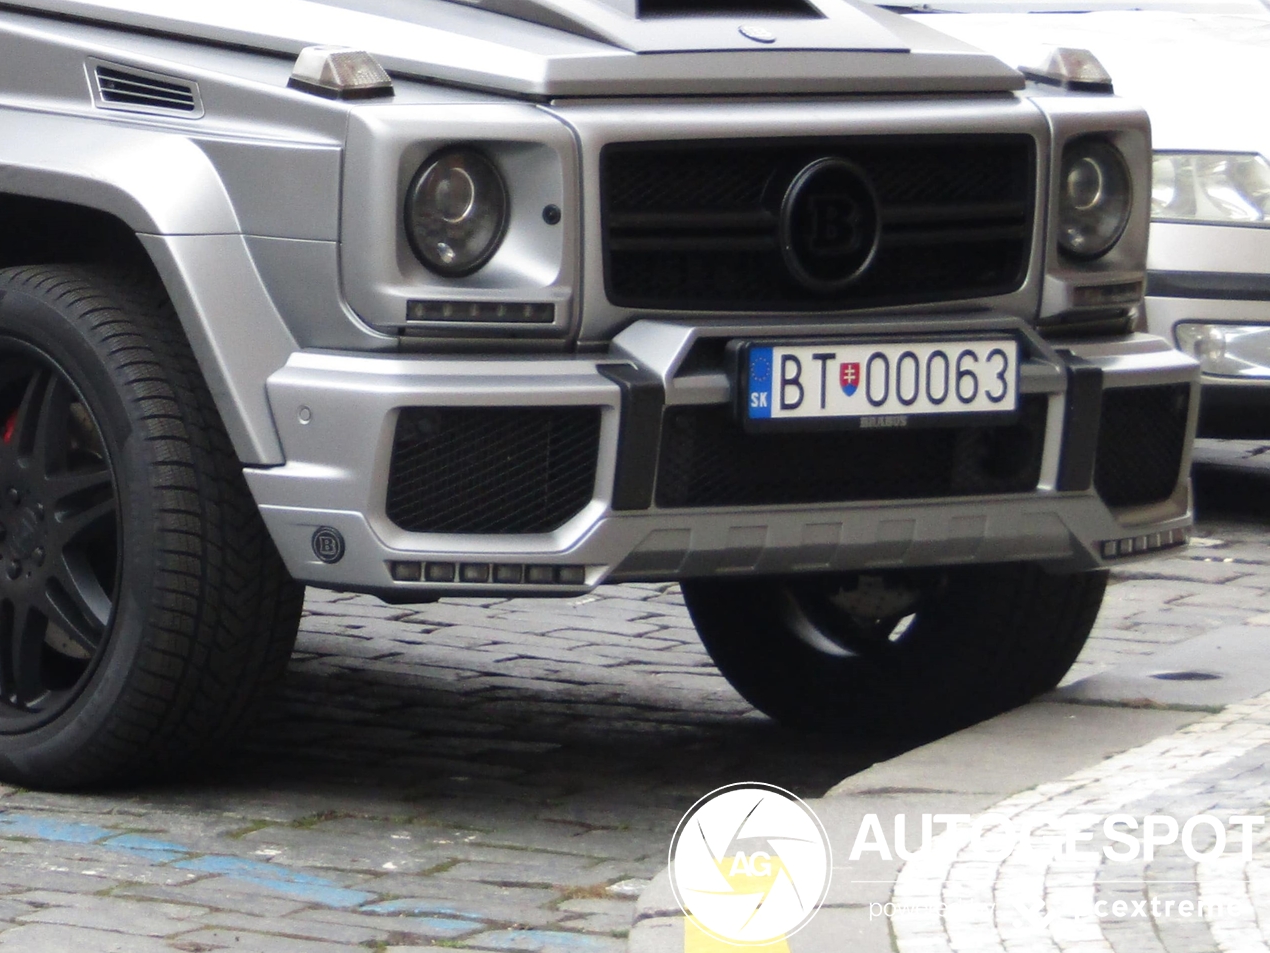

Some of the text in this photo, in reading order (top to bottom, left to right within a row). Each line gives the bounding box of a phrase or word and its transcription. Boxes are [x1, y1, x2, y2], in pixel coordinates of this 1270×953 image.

[780, 348, 1009, 410] BT 00063
[750, 392, 768, 408] SK
